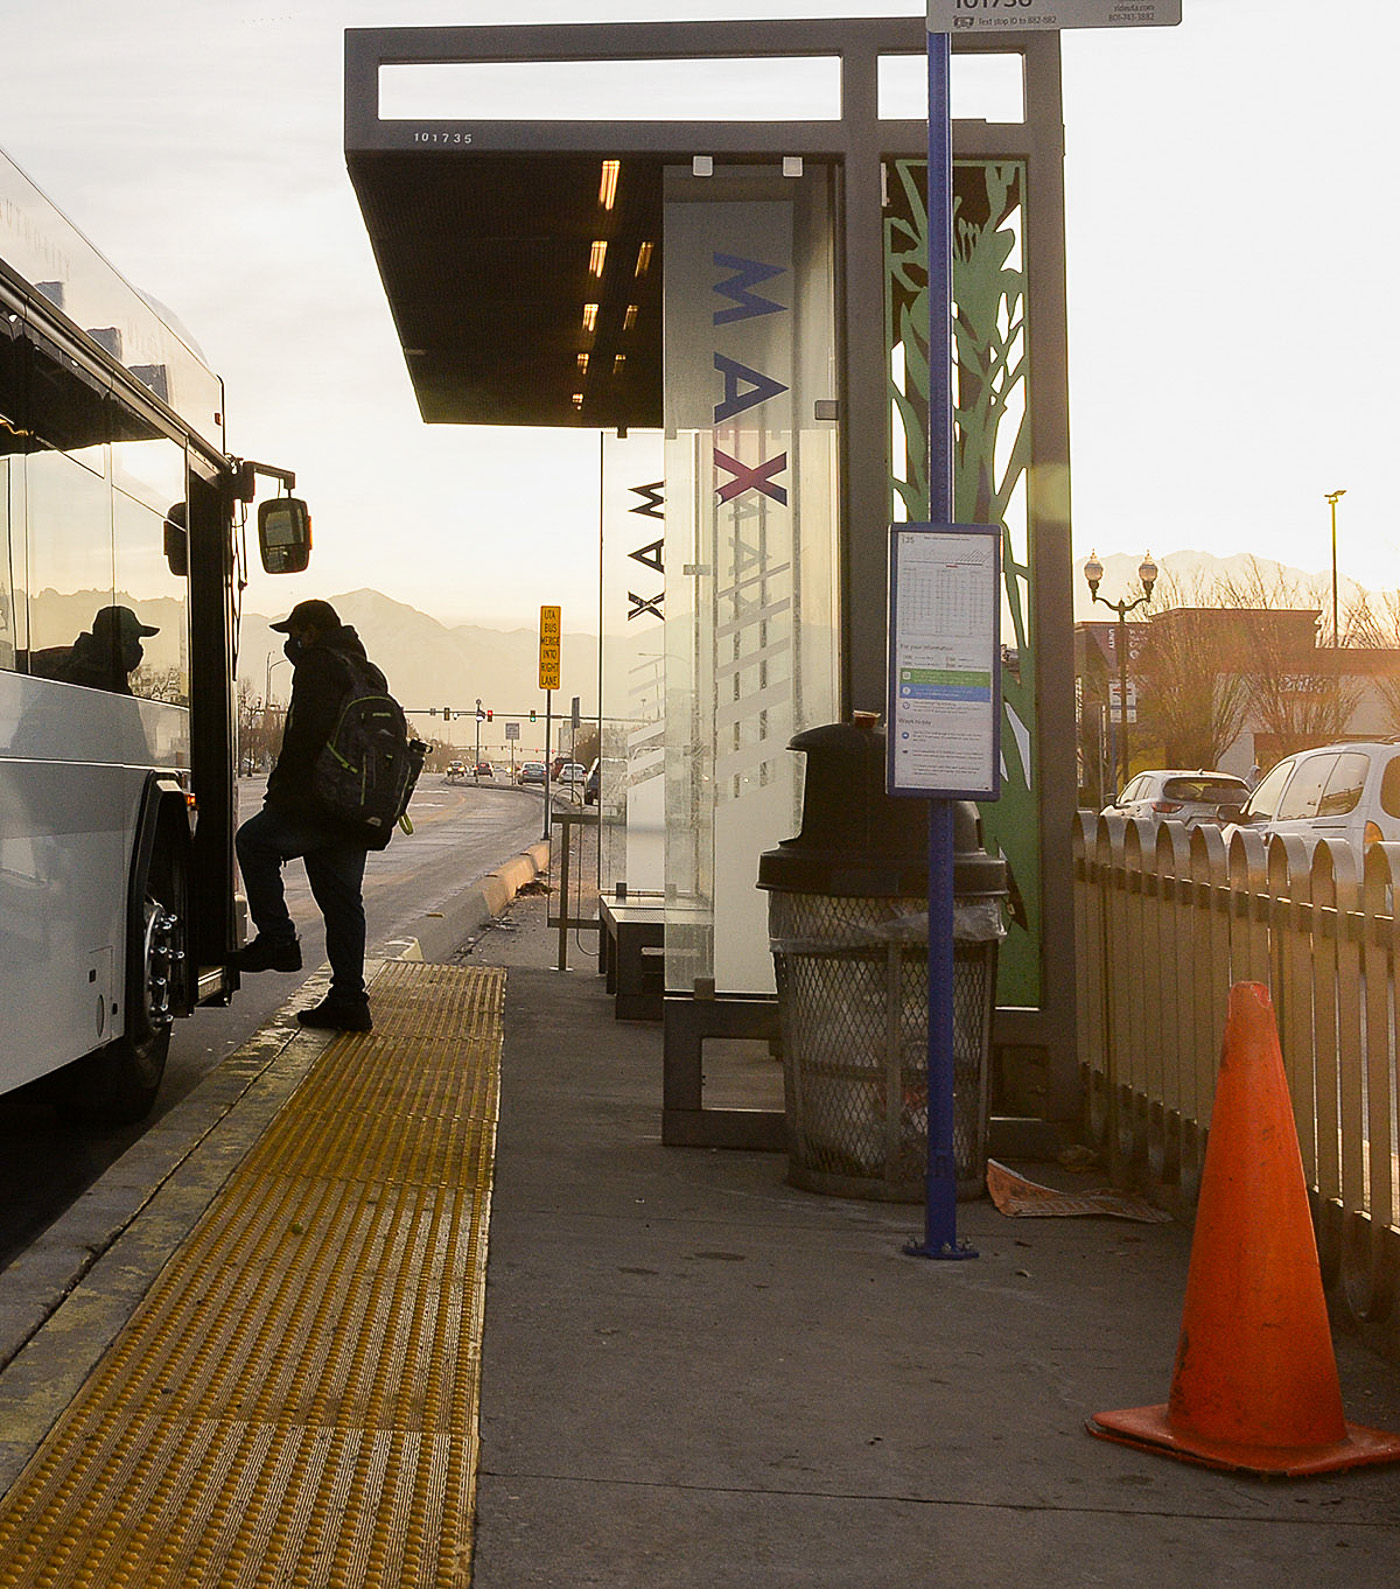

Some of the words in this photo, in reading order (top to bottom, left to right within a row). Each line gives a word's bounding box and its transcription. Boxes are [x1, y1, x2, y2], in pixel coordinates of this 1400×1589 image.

[414, 132, 472, 145] 101735
[712, 251, 790, 508] MAX
[544, 623, 557, 633] BUS
[543, 649, 557, 659] INTO
[541, 662, 559, 673] RIGHT
[541, 675, 557, 686] LANE
